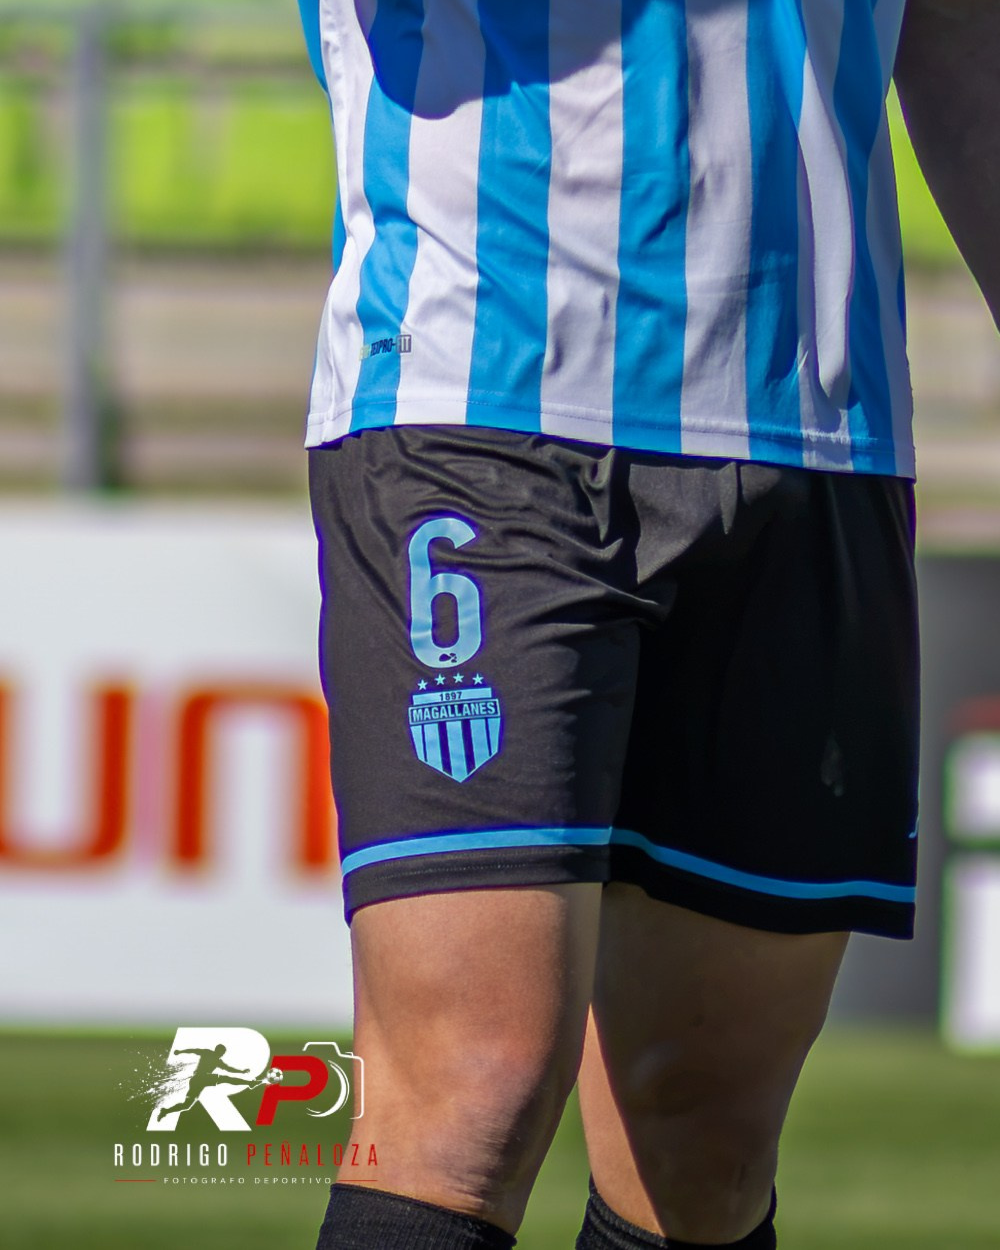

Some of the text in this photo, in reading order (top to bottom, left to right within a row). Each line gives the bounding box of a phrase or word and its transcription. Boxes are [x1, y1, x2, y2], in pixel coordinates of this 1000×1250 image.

[408, 517, 482, 669] 6
[439, 691, 463, 703] 1897
[411, 703, 497, 723] MAGALLANES
